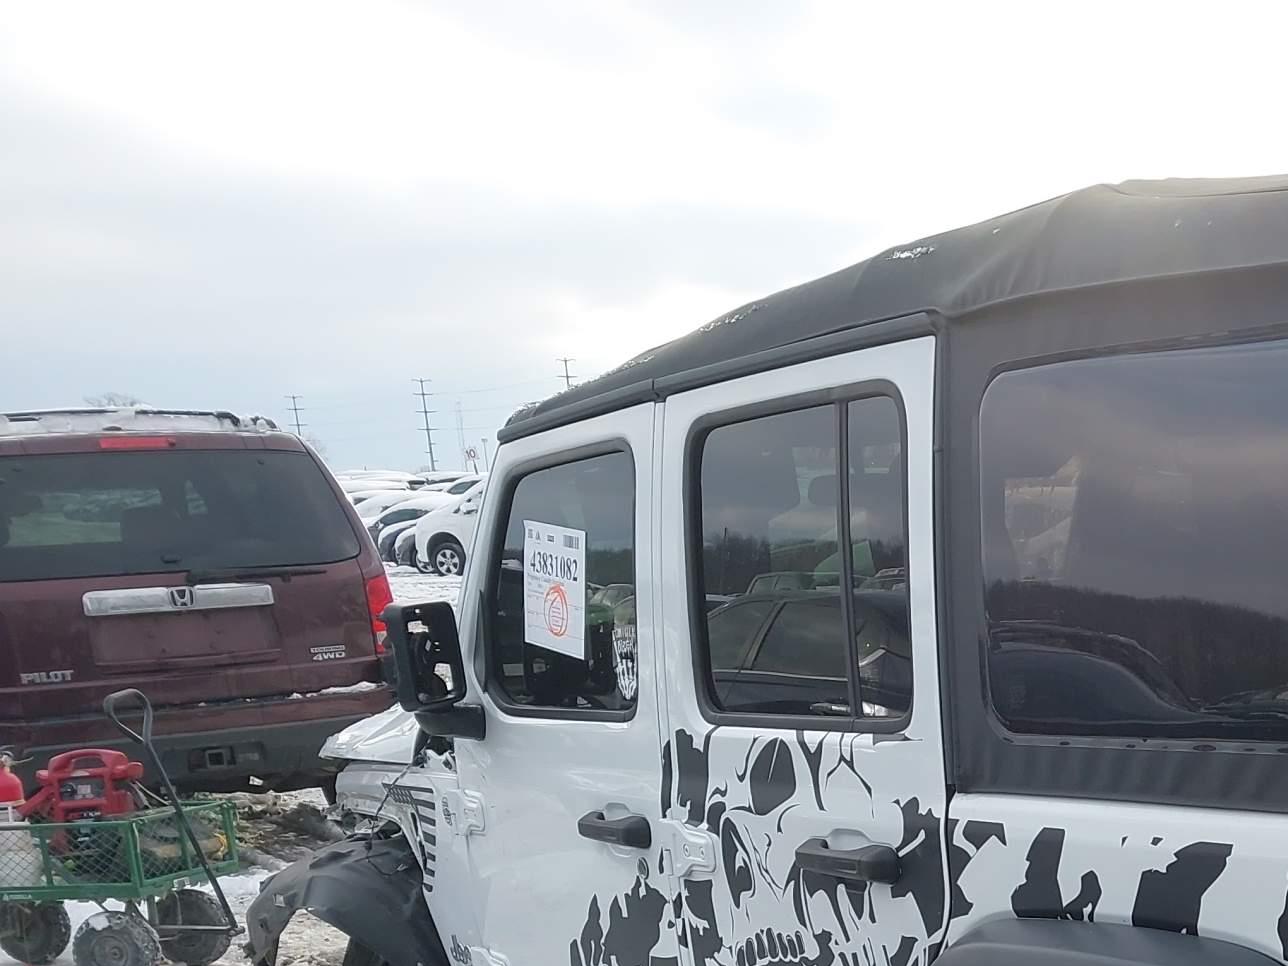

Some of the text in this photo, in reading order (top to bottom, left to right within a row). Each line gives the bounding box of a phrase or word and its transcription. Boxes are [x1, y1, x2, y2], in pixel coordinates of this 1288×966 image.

[530, 550, 578, 582] 43831082
[312, 651, 346, 661] 4WD
[20, 669, 74, 684] PILOT
